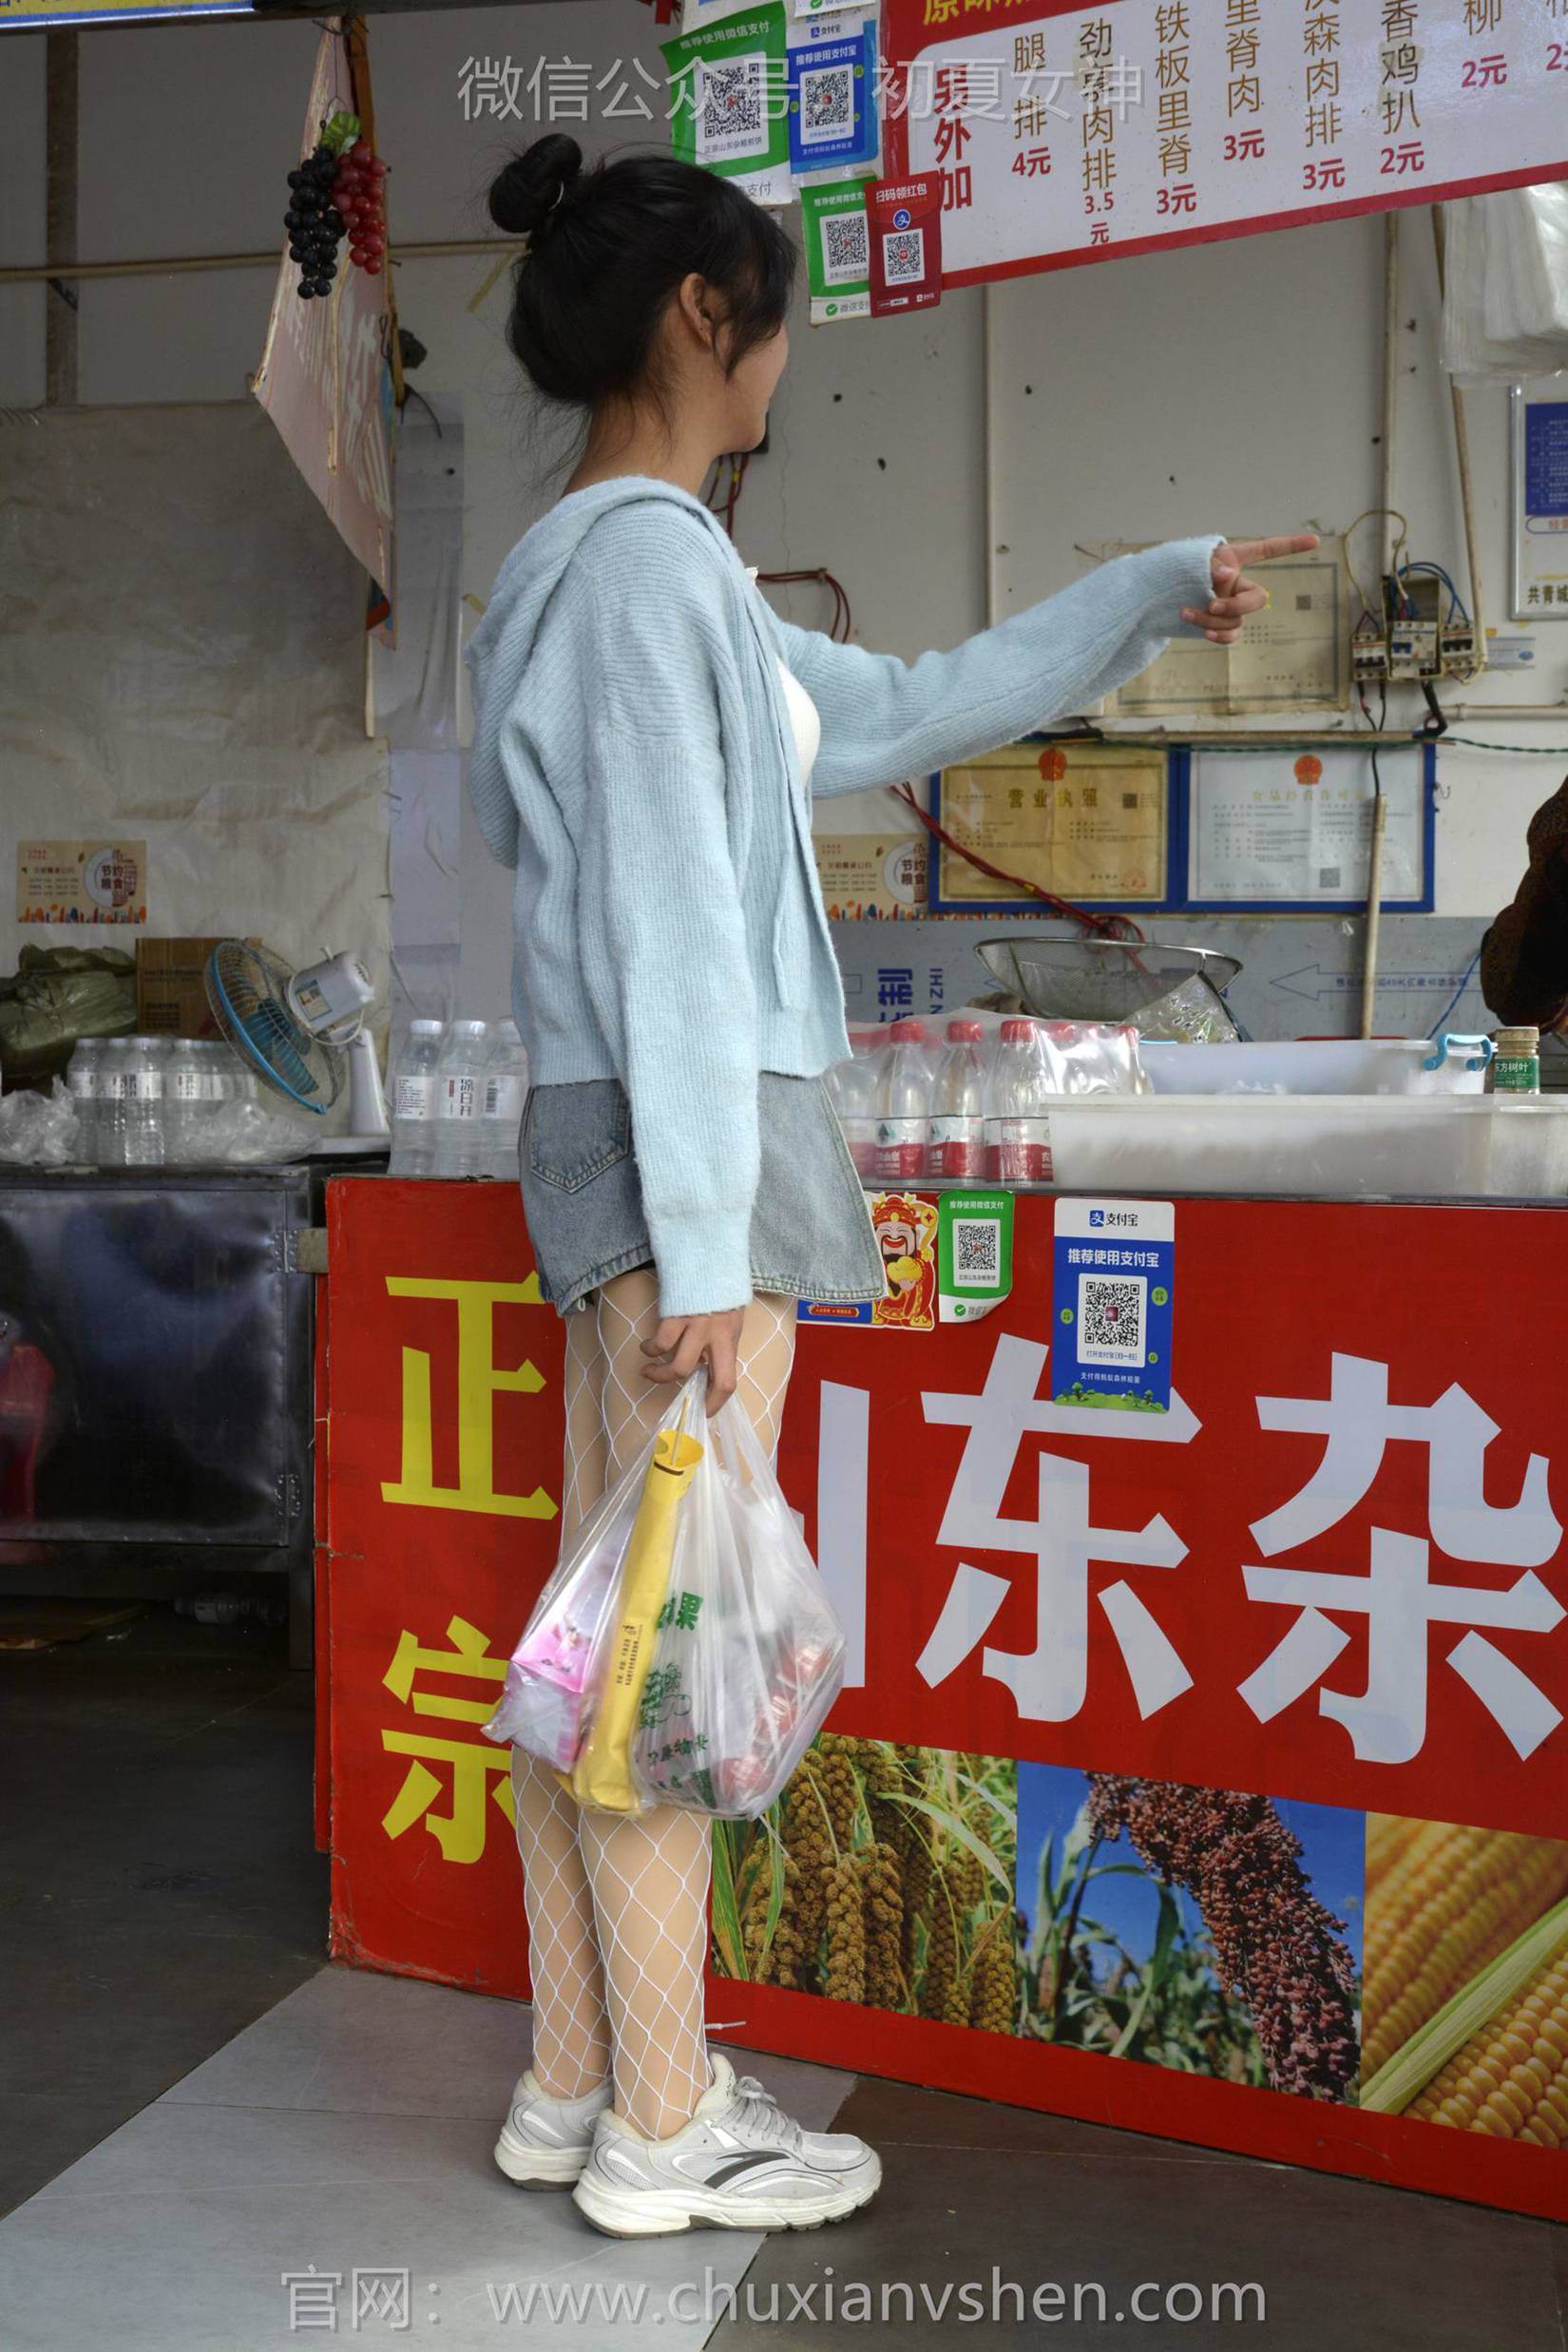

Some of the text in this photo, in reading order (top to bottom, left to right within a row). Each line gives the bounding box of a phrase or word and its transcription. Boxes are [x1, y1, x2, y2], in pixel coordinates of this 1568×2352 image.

[1461, 54, 1507, 88] 2元
[1546, 44, 1568, 70] 2
[1155, 1, 1192, 178] 铁板里脊
[1304, 0, 1343, 148] 森肉排
[1011, 146, 1052, 178] 4元
[1223, 129, 1265, 162] 3元
[1380, 142, 1425, 175] 2元
[1302, 158, 1346, 190] 3元
[1156, 183, 1197, 216] 3元
[1084, 192, 1114, 245] 3.5 元
[1007, 788, 1099, 809] 营业执照
[1105, 1212, 1138, 1227] 支付宝
[1067, 1247, 1159, 1268] 推荐使用支付宝
[380, 1270, 560, 1865] 正宗
